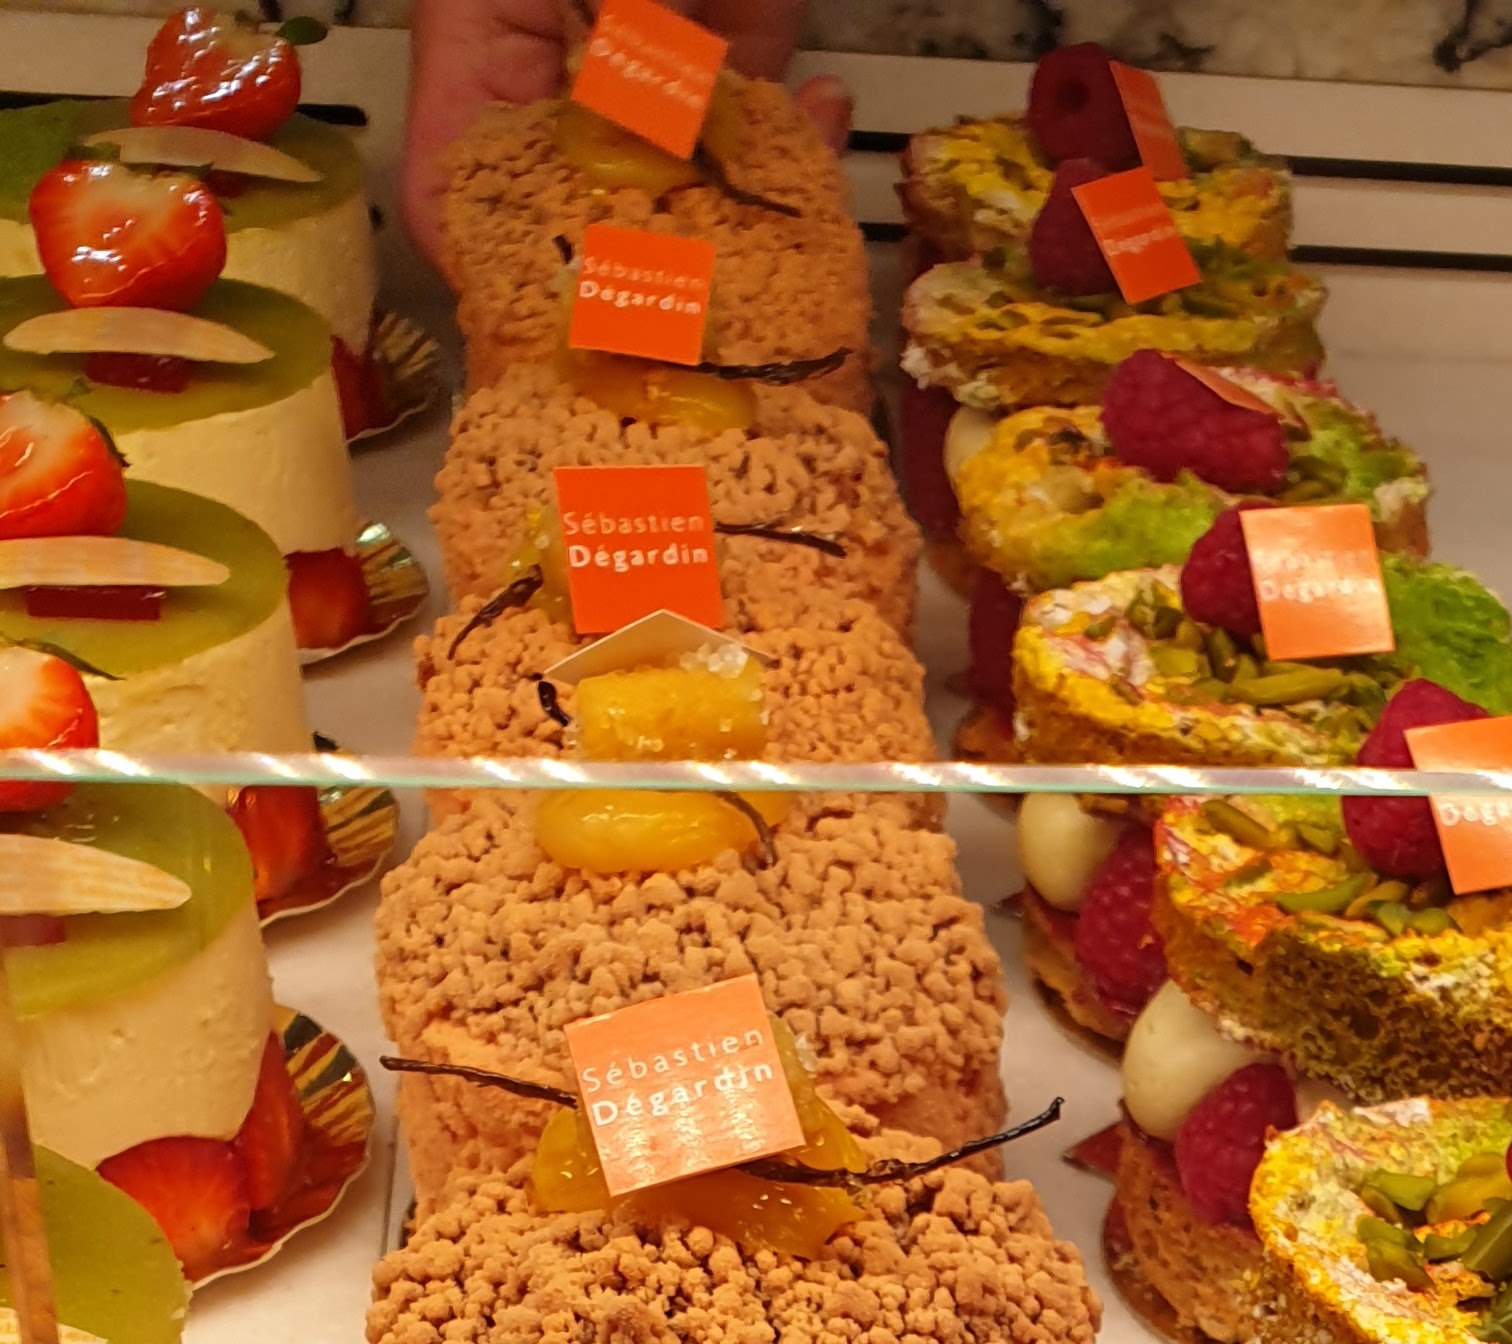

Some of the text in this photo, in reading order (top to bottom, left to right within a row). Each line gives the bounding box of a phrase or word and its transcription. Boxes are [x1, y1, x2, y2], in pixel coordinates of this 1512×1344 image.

[562, 511, 704, 535] Sébastien
[568, 543, 708, 572] Dégardin
[581, 1029, 763, 1093] Sébastien
[591, 1062, 773, 1126] Dégardin
